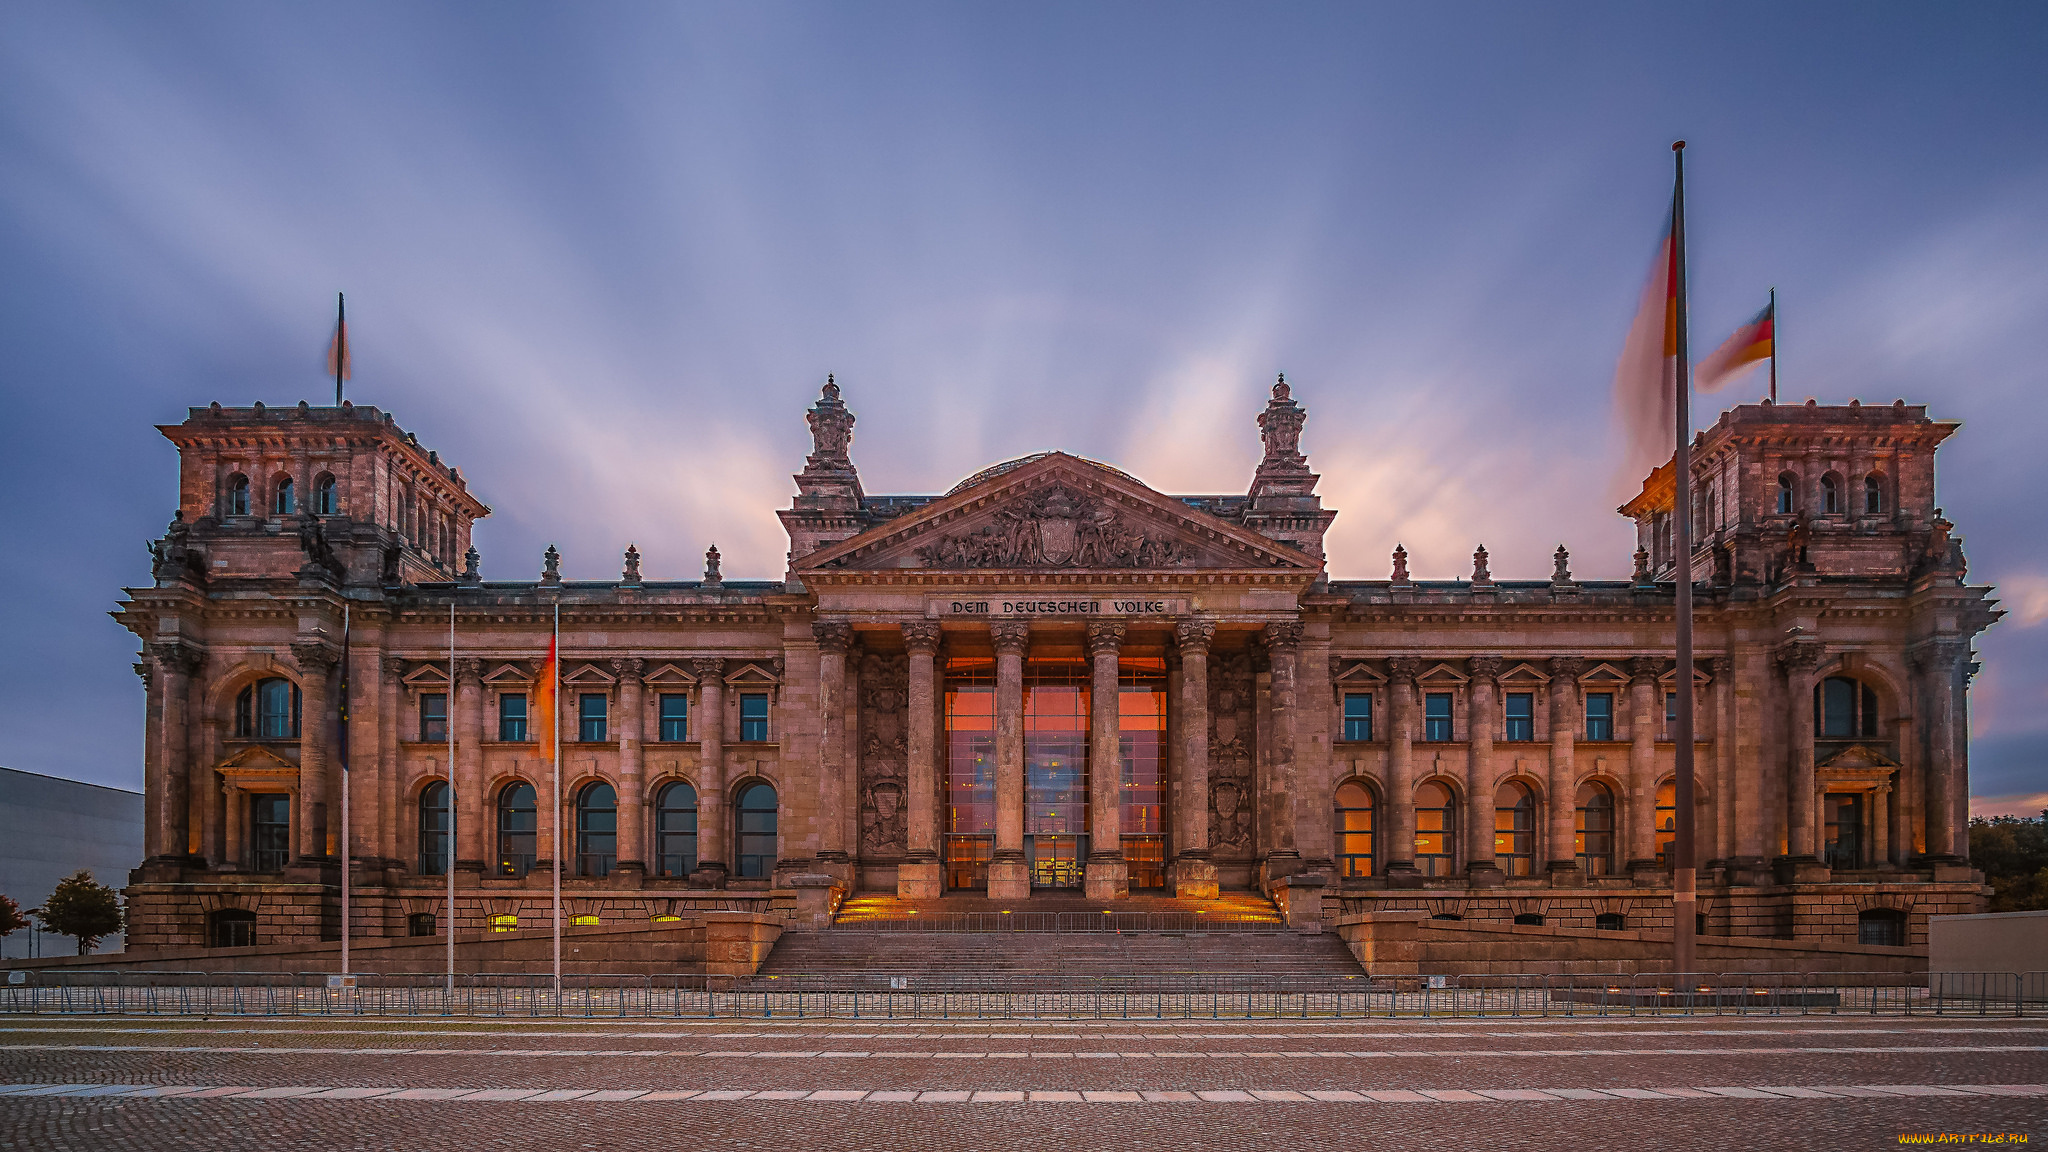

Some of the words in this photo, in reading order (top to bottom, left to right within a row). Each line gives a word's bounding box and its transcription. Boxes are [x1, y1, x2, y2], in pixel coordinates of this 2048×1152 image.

[952, 601, 989, 614] DEM
[1003, 601, 1099, 614] DEUTSCHEN
[1114, 601, 1164, 613] VOLKE
